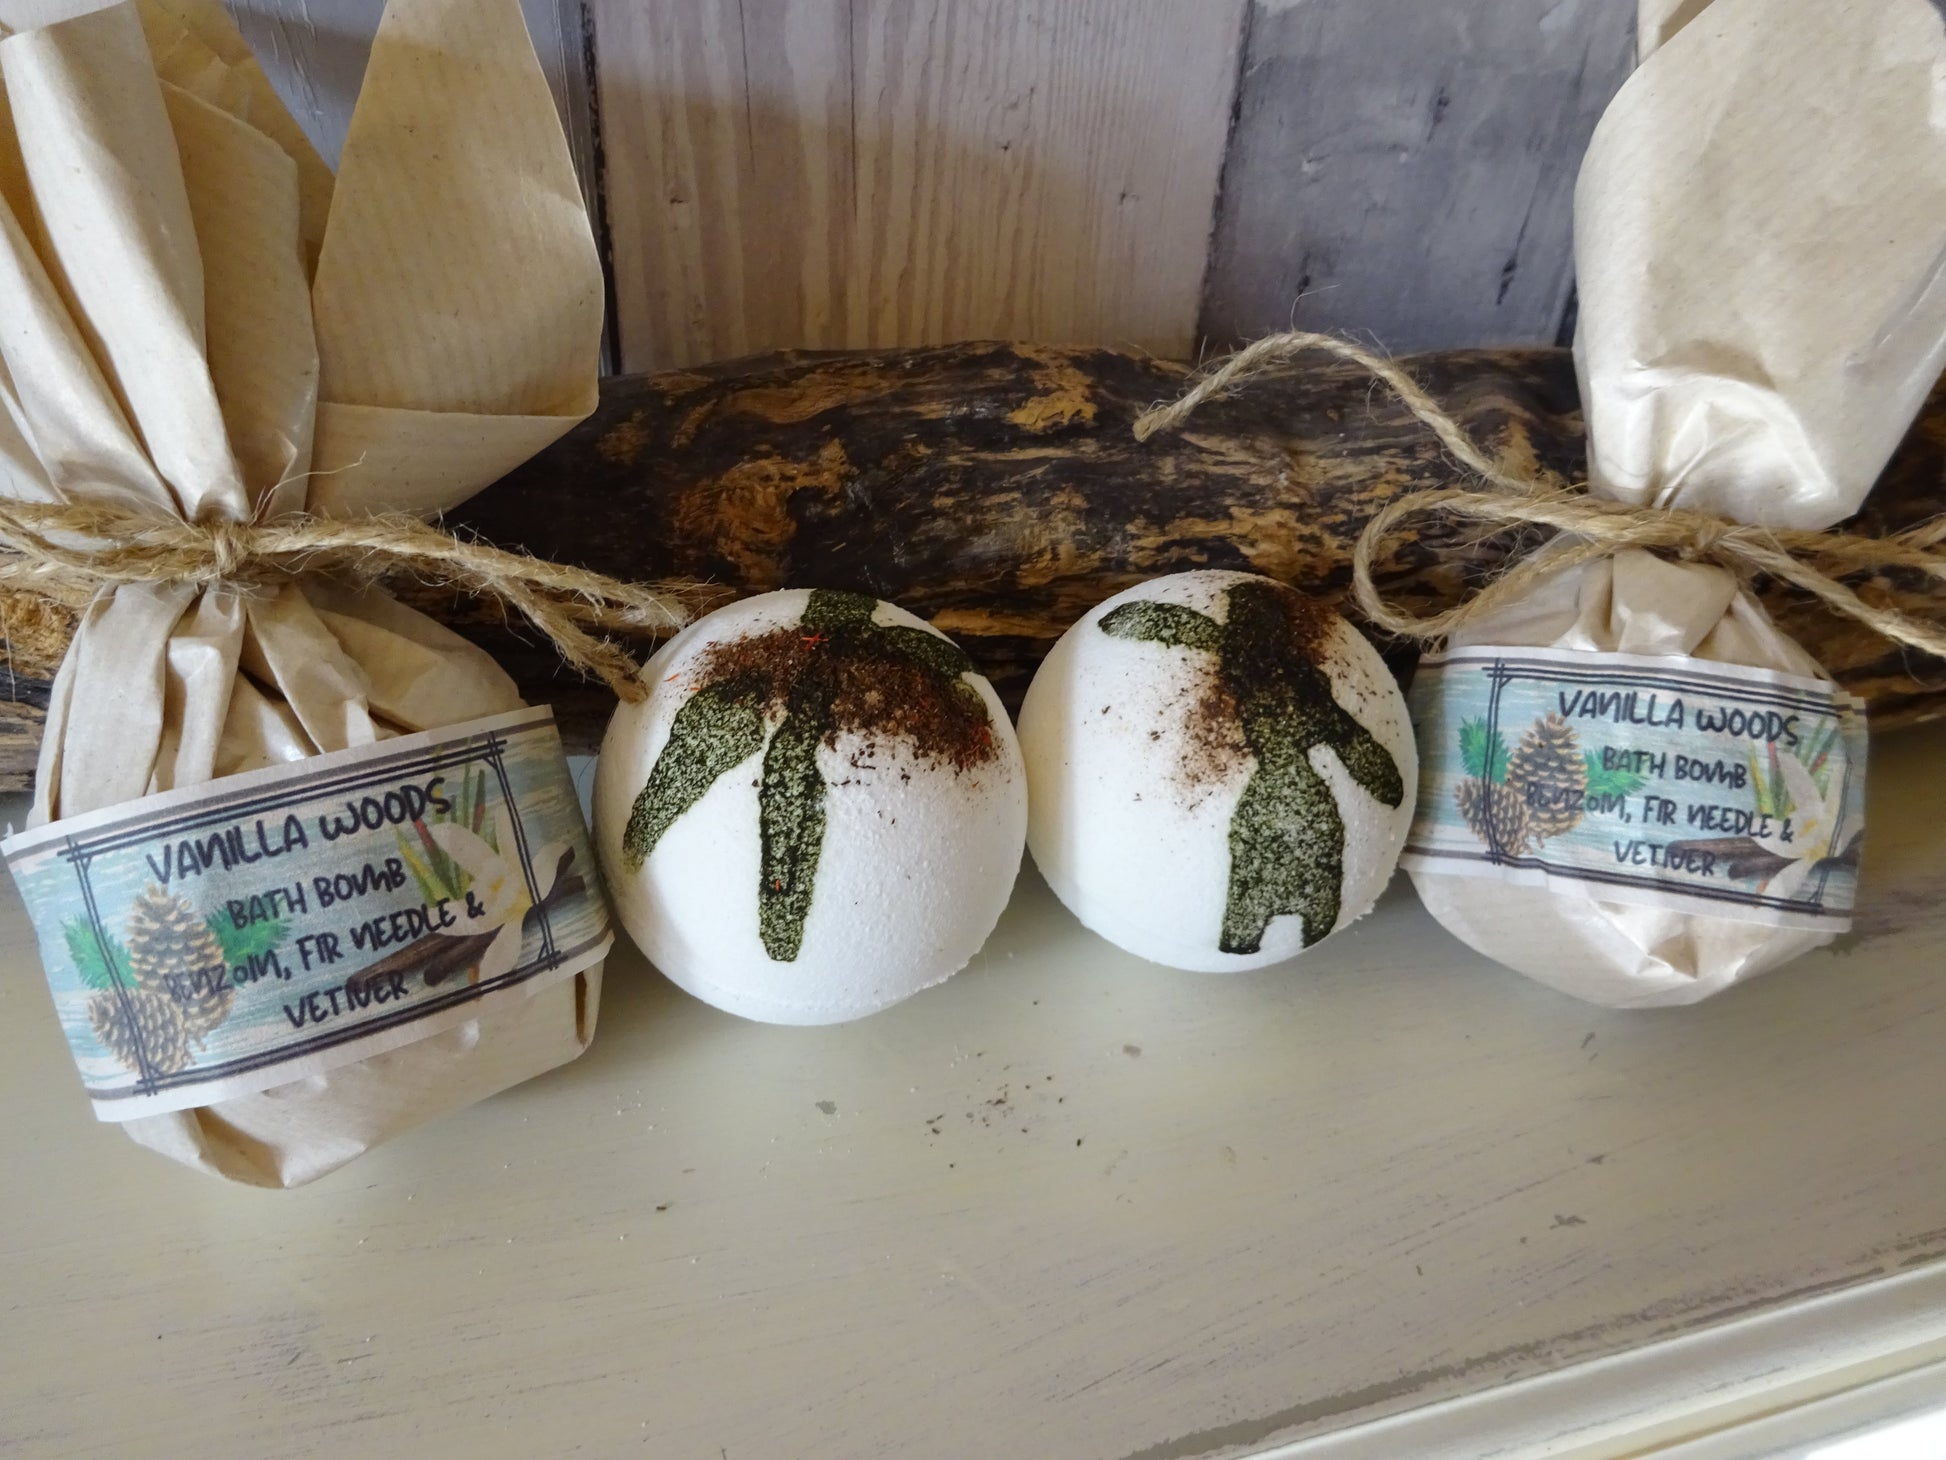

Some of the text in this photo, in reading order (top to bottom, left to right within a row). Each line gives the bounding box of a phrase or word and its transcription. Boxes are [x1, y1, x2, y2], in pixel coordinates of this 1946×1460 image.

[1558, 689, 1800, 746] VANILLA WOODS
[1602, 745, 1748, 789] BATH BOMB
[146, 777, 451, 884] VANILLA WOODS
[1642, 794, 1677, 826] FIR
[1687, 803, 1773, 839] NEEDLE
[1780, 817, 1794, 843] &
[1614, 840, 1717, 877] VETIVER
[226, 857, 408, 931] BATH BOMB
[295, 932, 344, 971] FIR
[350, 897, 457, 951] NEEDLE
[466, 891, 486, 919] &
[283, 971, 409, 1029] VETIVER
